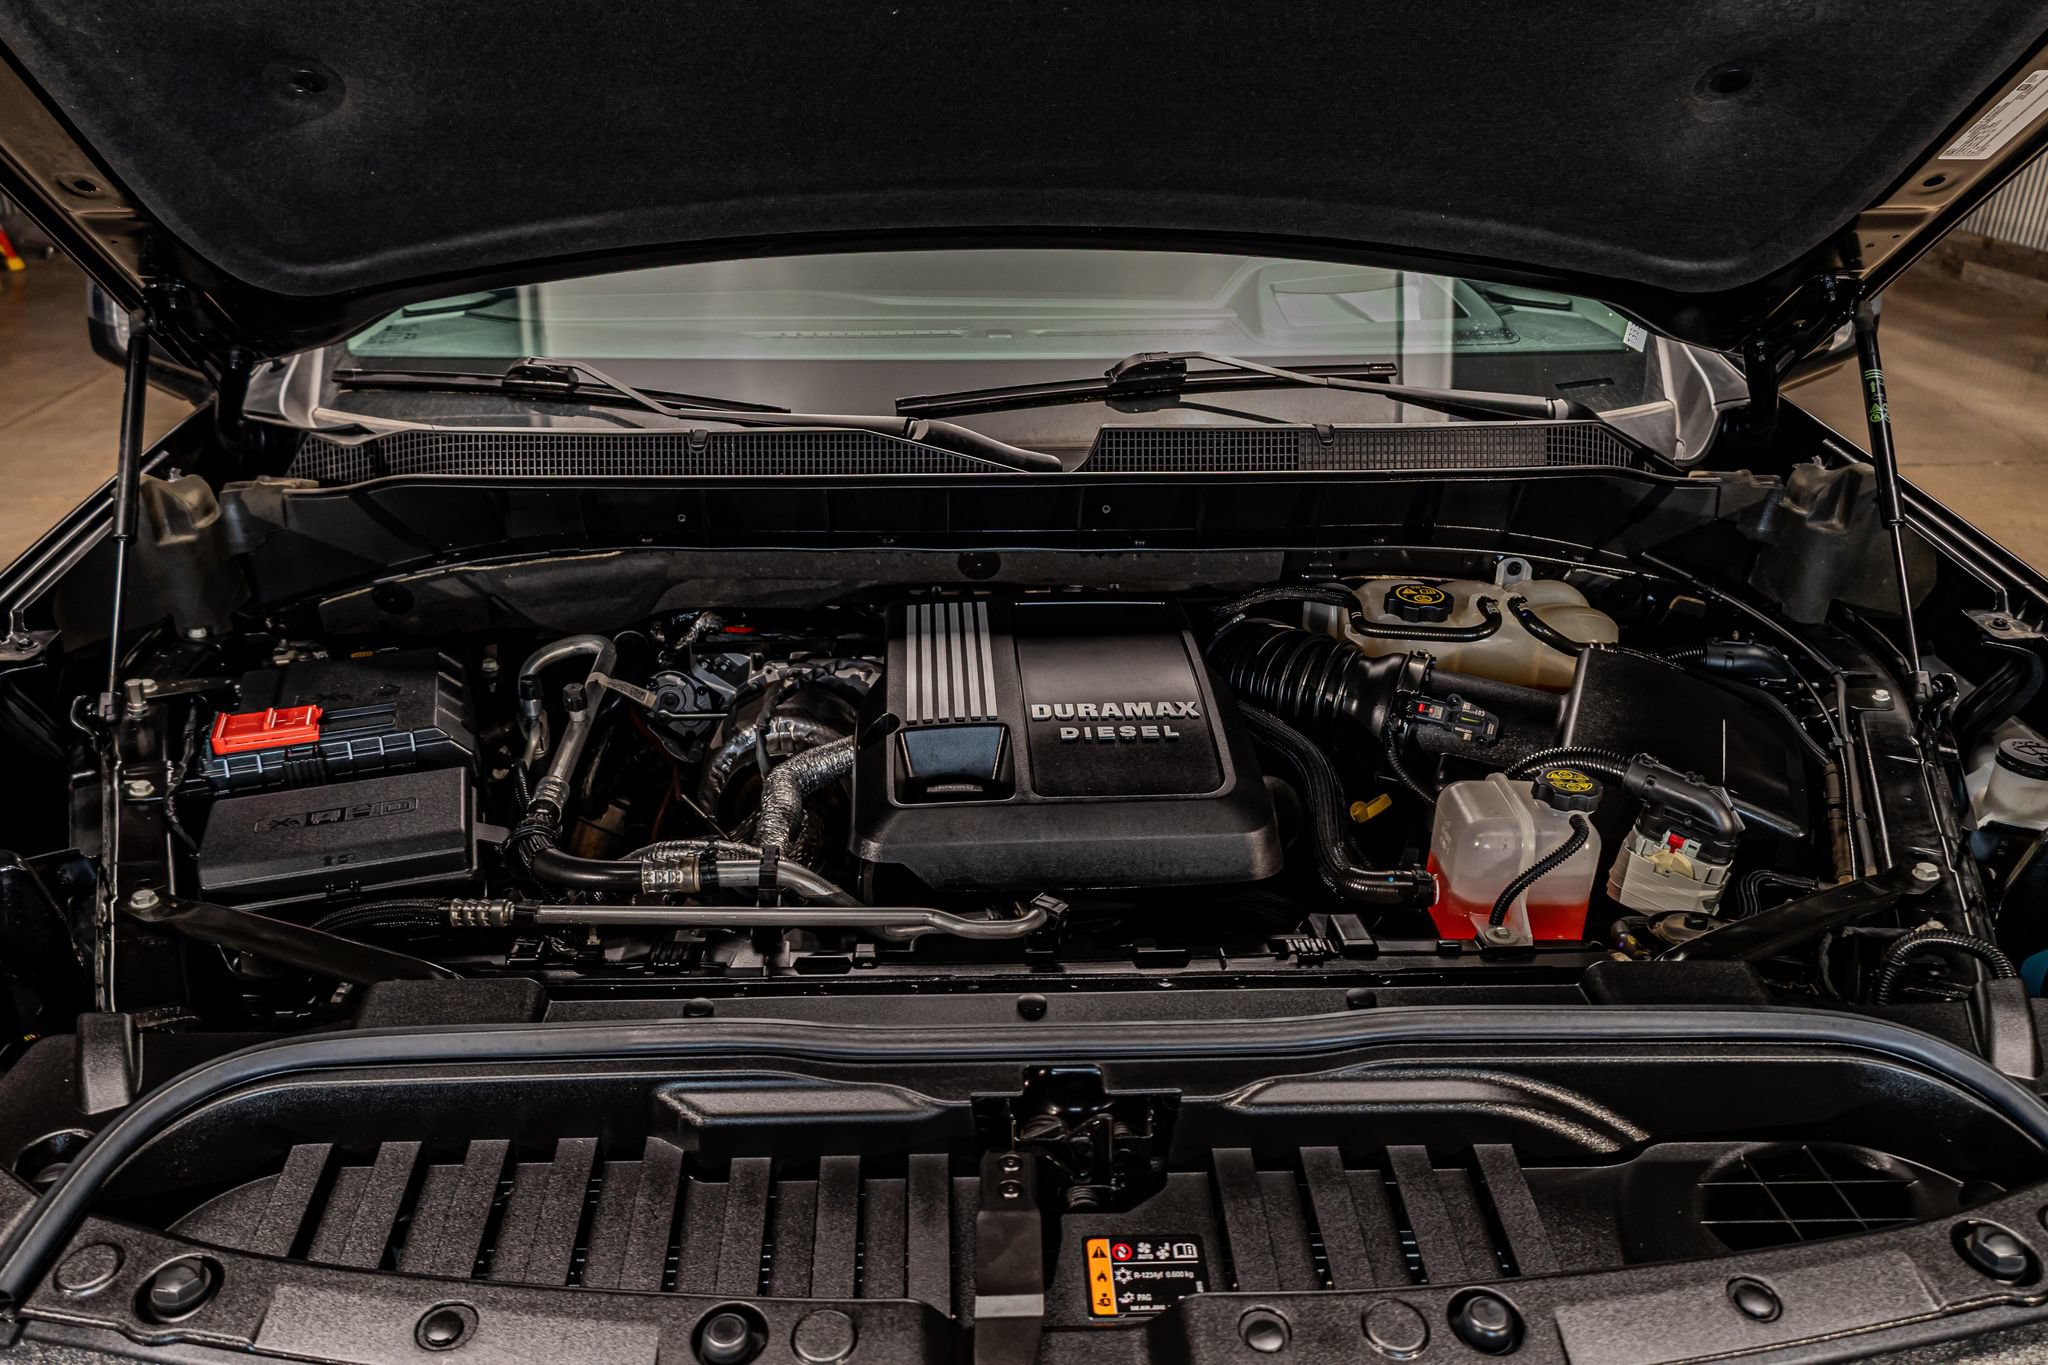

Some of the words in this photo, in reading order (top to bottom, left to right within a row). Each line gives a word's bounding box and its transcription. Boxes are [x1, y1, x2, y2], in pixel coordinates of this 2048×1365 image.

[1031, 701, 1200, 721] DURAMAX
[1060, 725, 1180, 741] DIESEL
[1136, 1293, 1152, 1301] PAG
